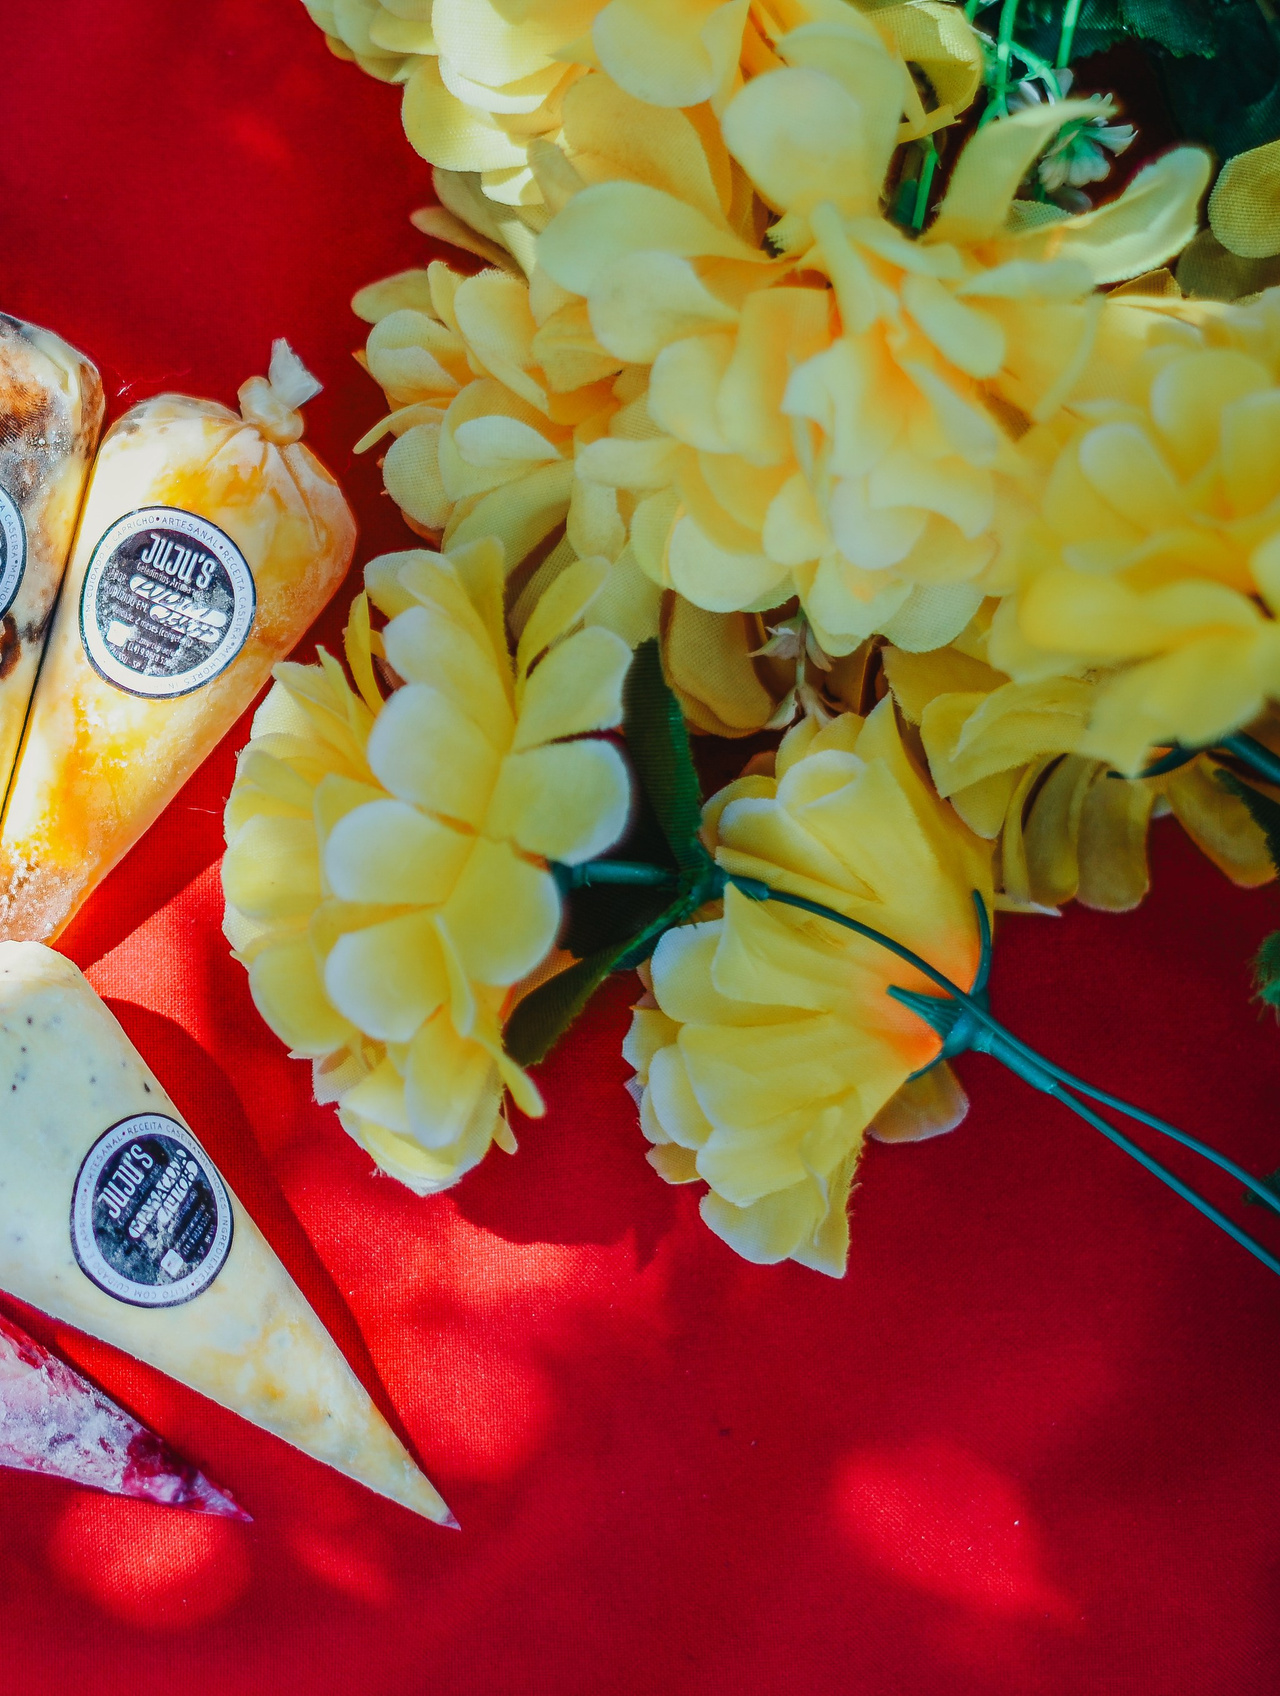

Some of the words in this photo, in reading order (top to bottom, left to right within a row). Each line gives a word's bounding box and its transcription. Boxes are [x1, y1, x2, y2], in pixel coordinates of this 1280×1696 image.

[4, 514, 18, 557] CASEIRA
[113, 515, 155, 542] CAPRICHO
[162, 517, 218, 548] ARTESANAL
[141, 533, 217, 589] JUJU'S
[222, 550, 245, 591] RECEITA
[231, 596, 246, 640] CASEIRA
[127, 1122, 163, 1135] RECEITA
[166, 1124, 198, 1153] CASEIRA
[86, 1134, 123, 1187] ARTESANAL
[97, 1144, 154, 1219] JUJU'S
[193, 1215, 228, 1285] INGREDIENTES
[133, 1287, 156, 1299] COM
